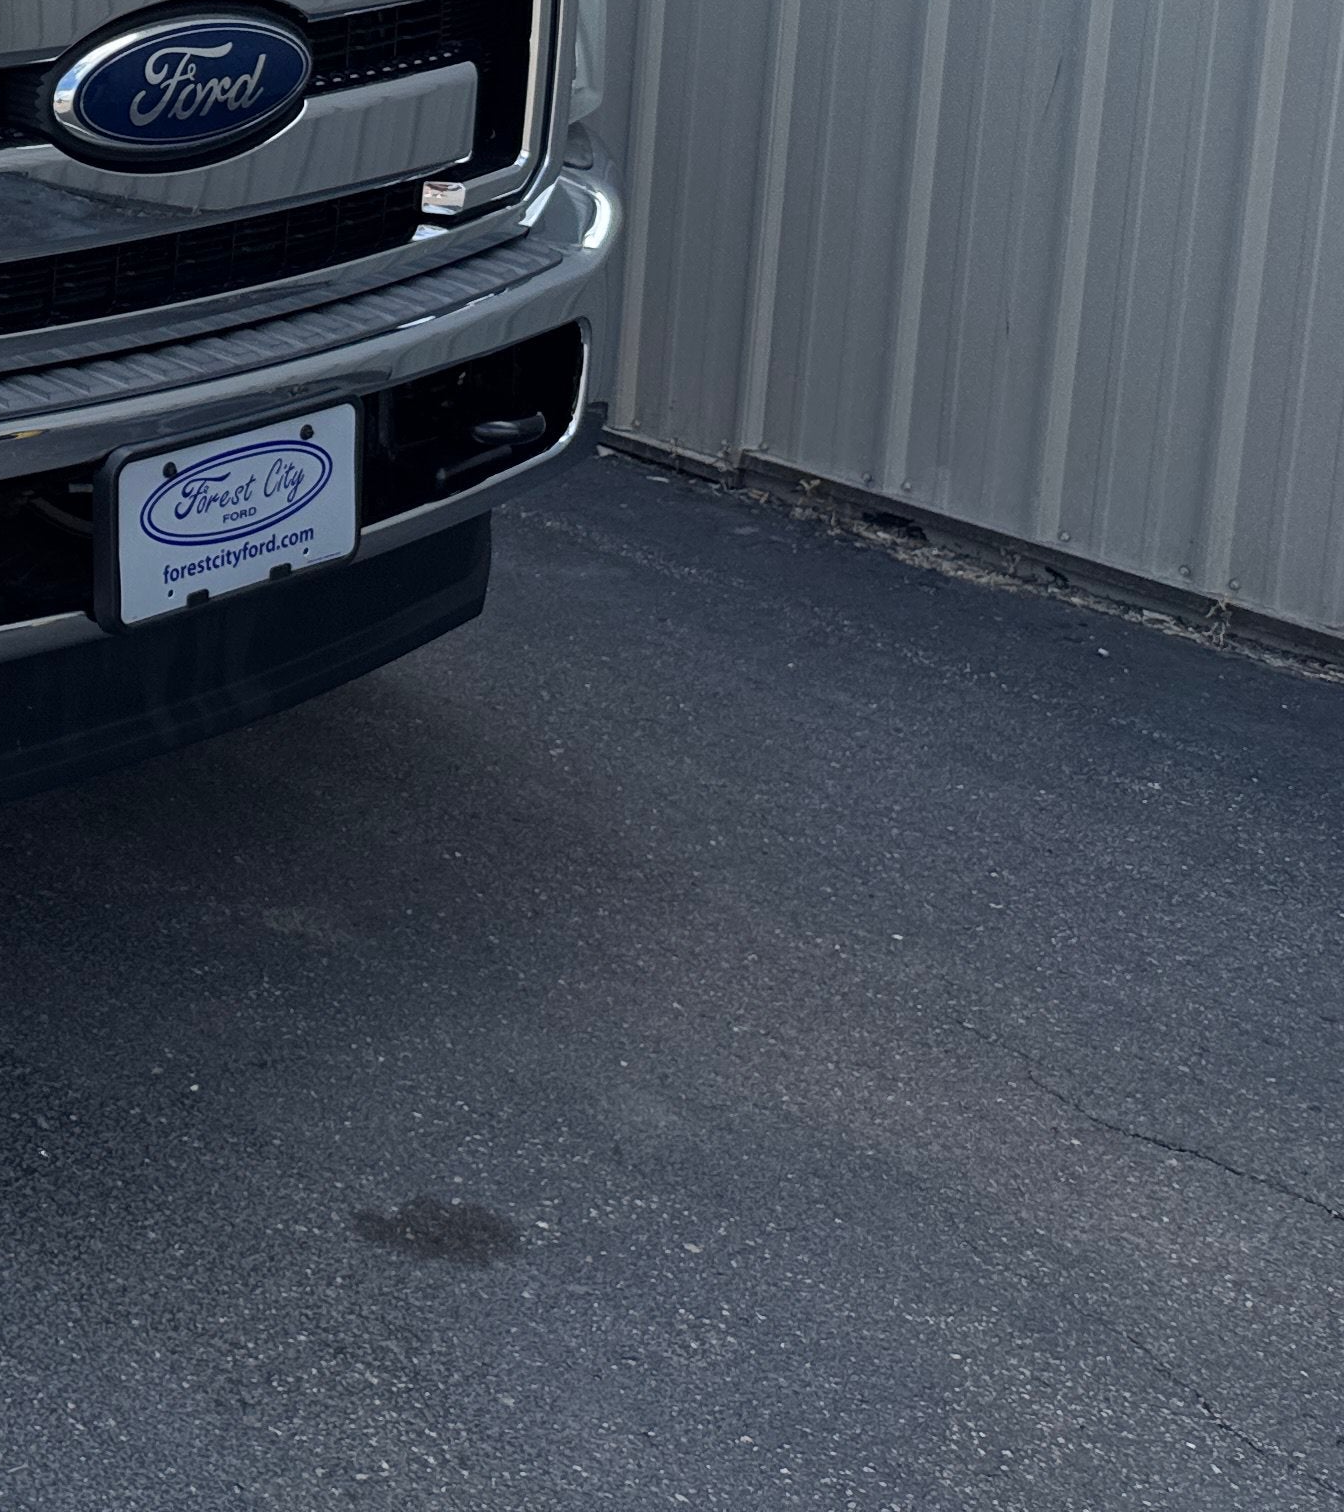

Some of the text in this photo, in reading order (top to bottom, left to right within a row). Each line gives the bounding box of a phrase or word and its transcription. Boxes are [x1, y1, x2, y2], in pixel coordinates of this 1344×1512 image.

[129, 41, 267, 126] Ford
[174, 458, 305, 520] Forest City
[222, 506, 257, 524] FORD
[162, 527, 314, 584] forestcityford.com
